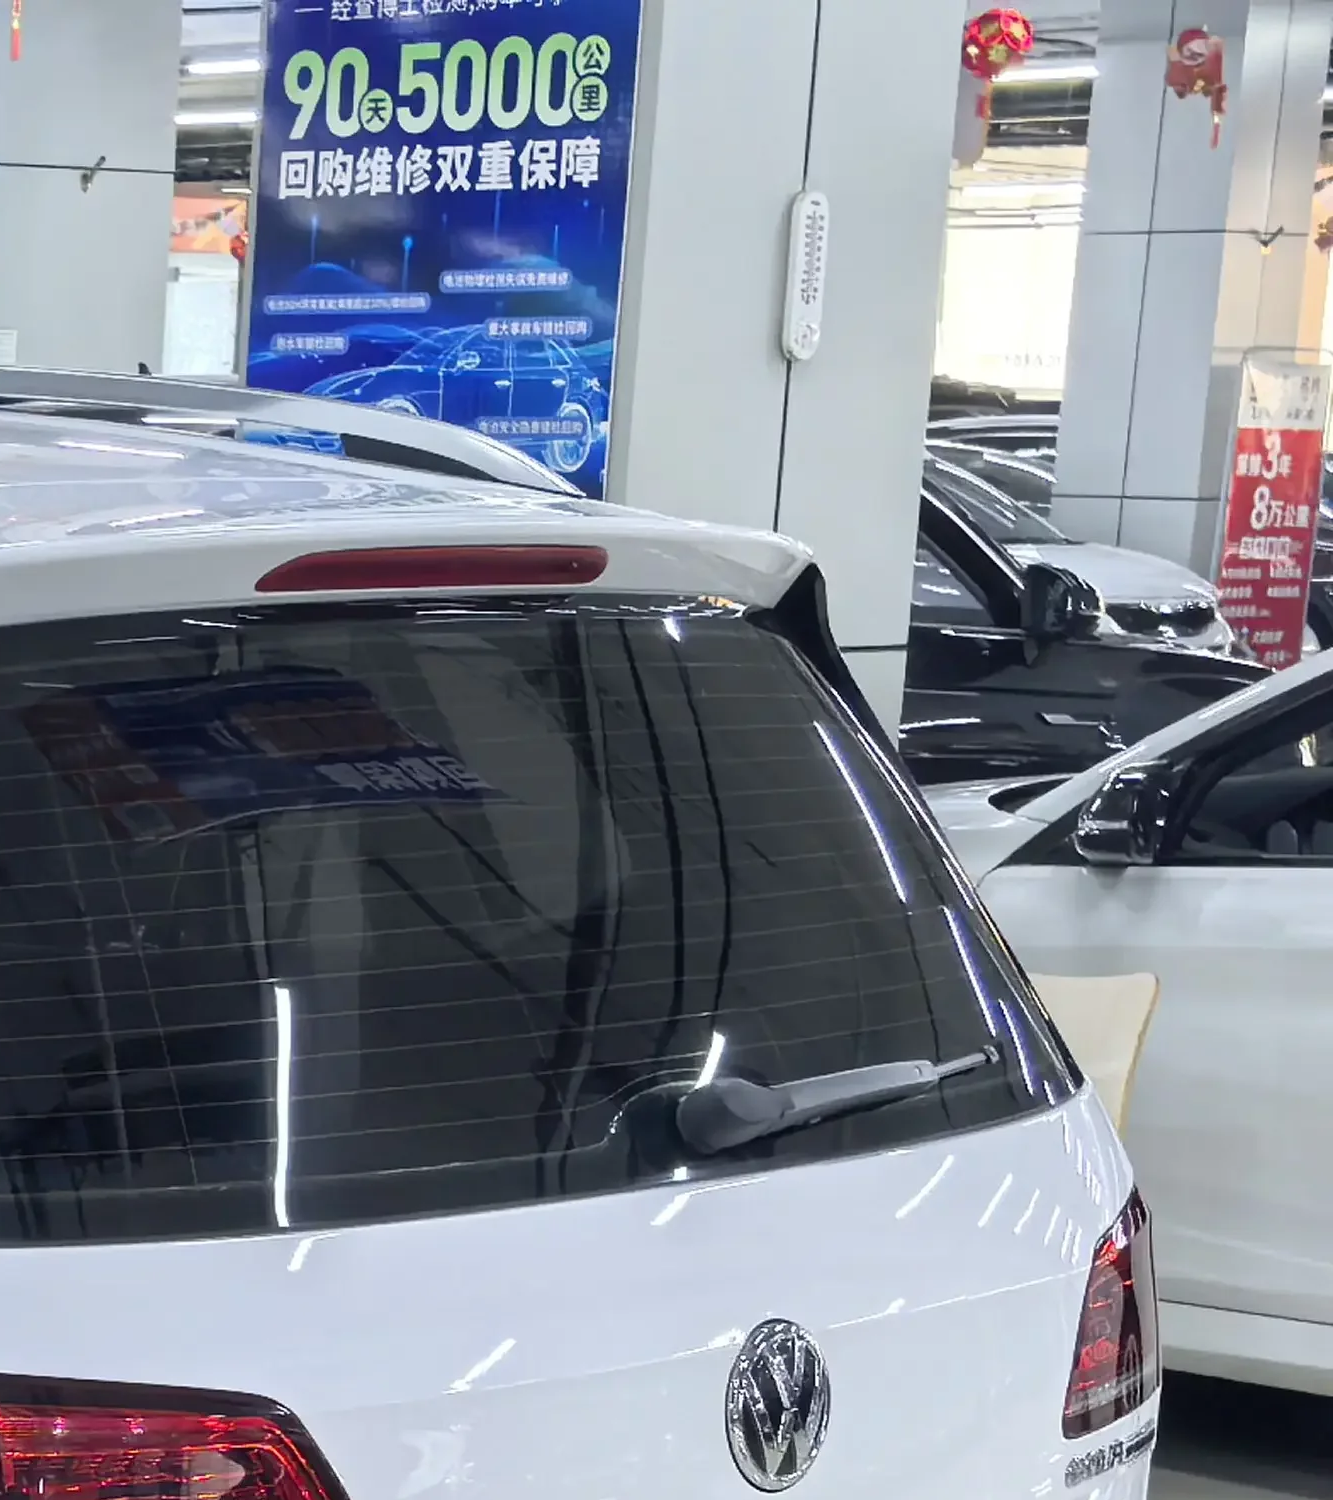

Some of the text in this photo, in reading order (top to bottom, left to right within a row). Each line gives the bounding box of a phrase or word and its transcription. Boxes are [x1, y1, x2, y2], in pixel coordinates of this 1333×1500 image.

[277, 136, 602, 200] 回购维修双重保障
